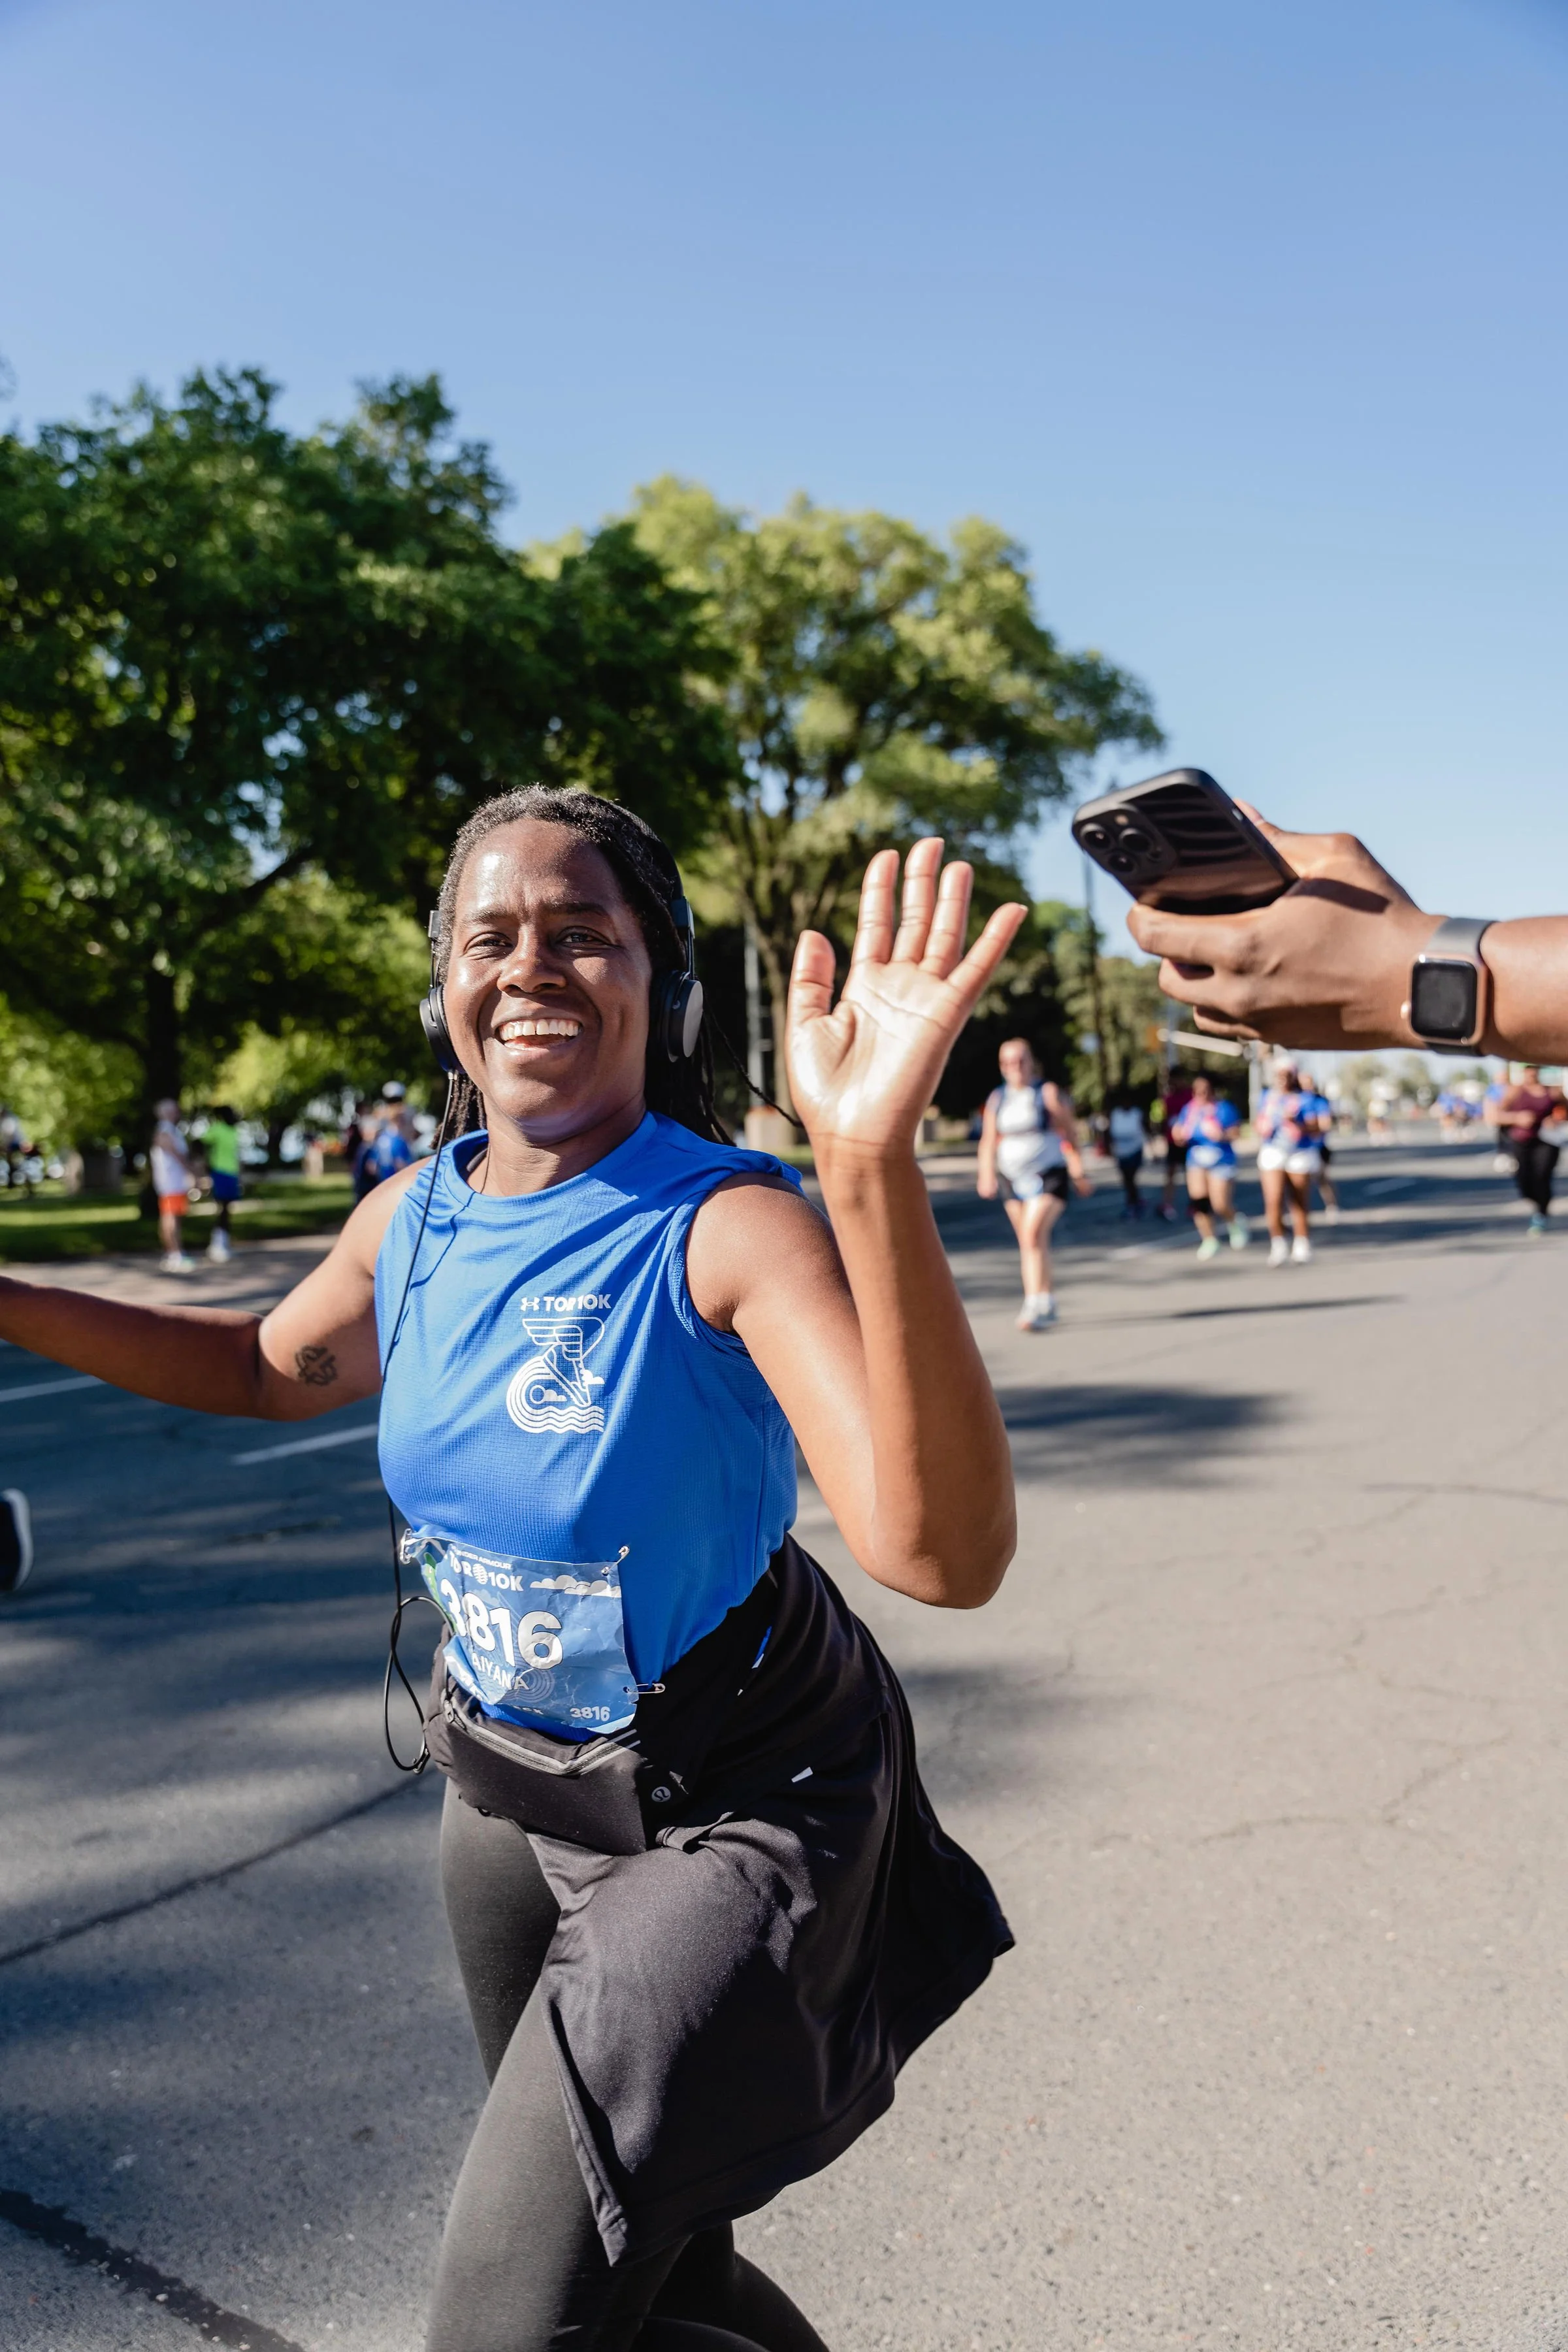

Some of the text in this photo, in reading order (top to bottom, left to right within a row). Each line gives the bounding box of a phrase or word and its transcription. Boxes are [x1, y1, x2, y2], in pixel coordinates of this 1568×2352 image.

[478, 1556, 513, 1570] ARMOUR
[440, 1578, 563, 1669] 3816
[471, 1652, 529, 1690] AIYANA
[569, 1706, 611, 1722] 3816
